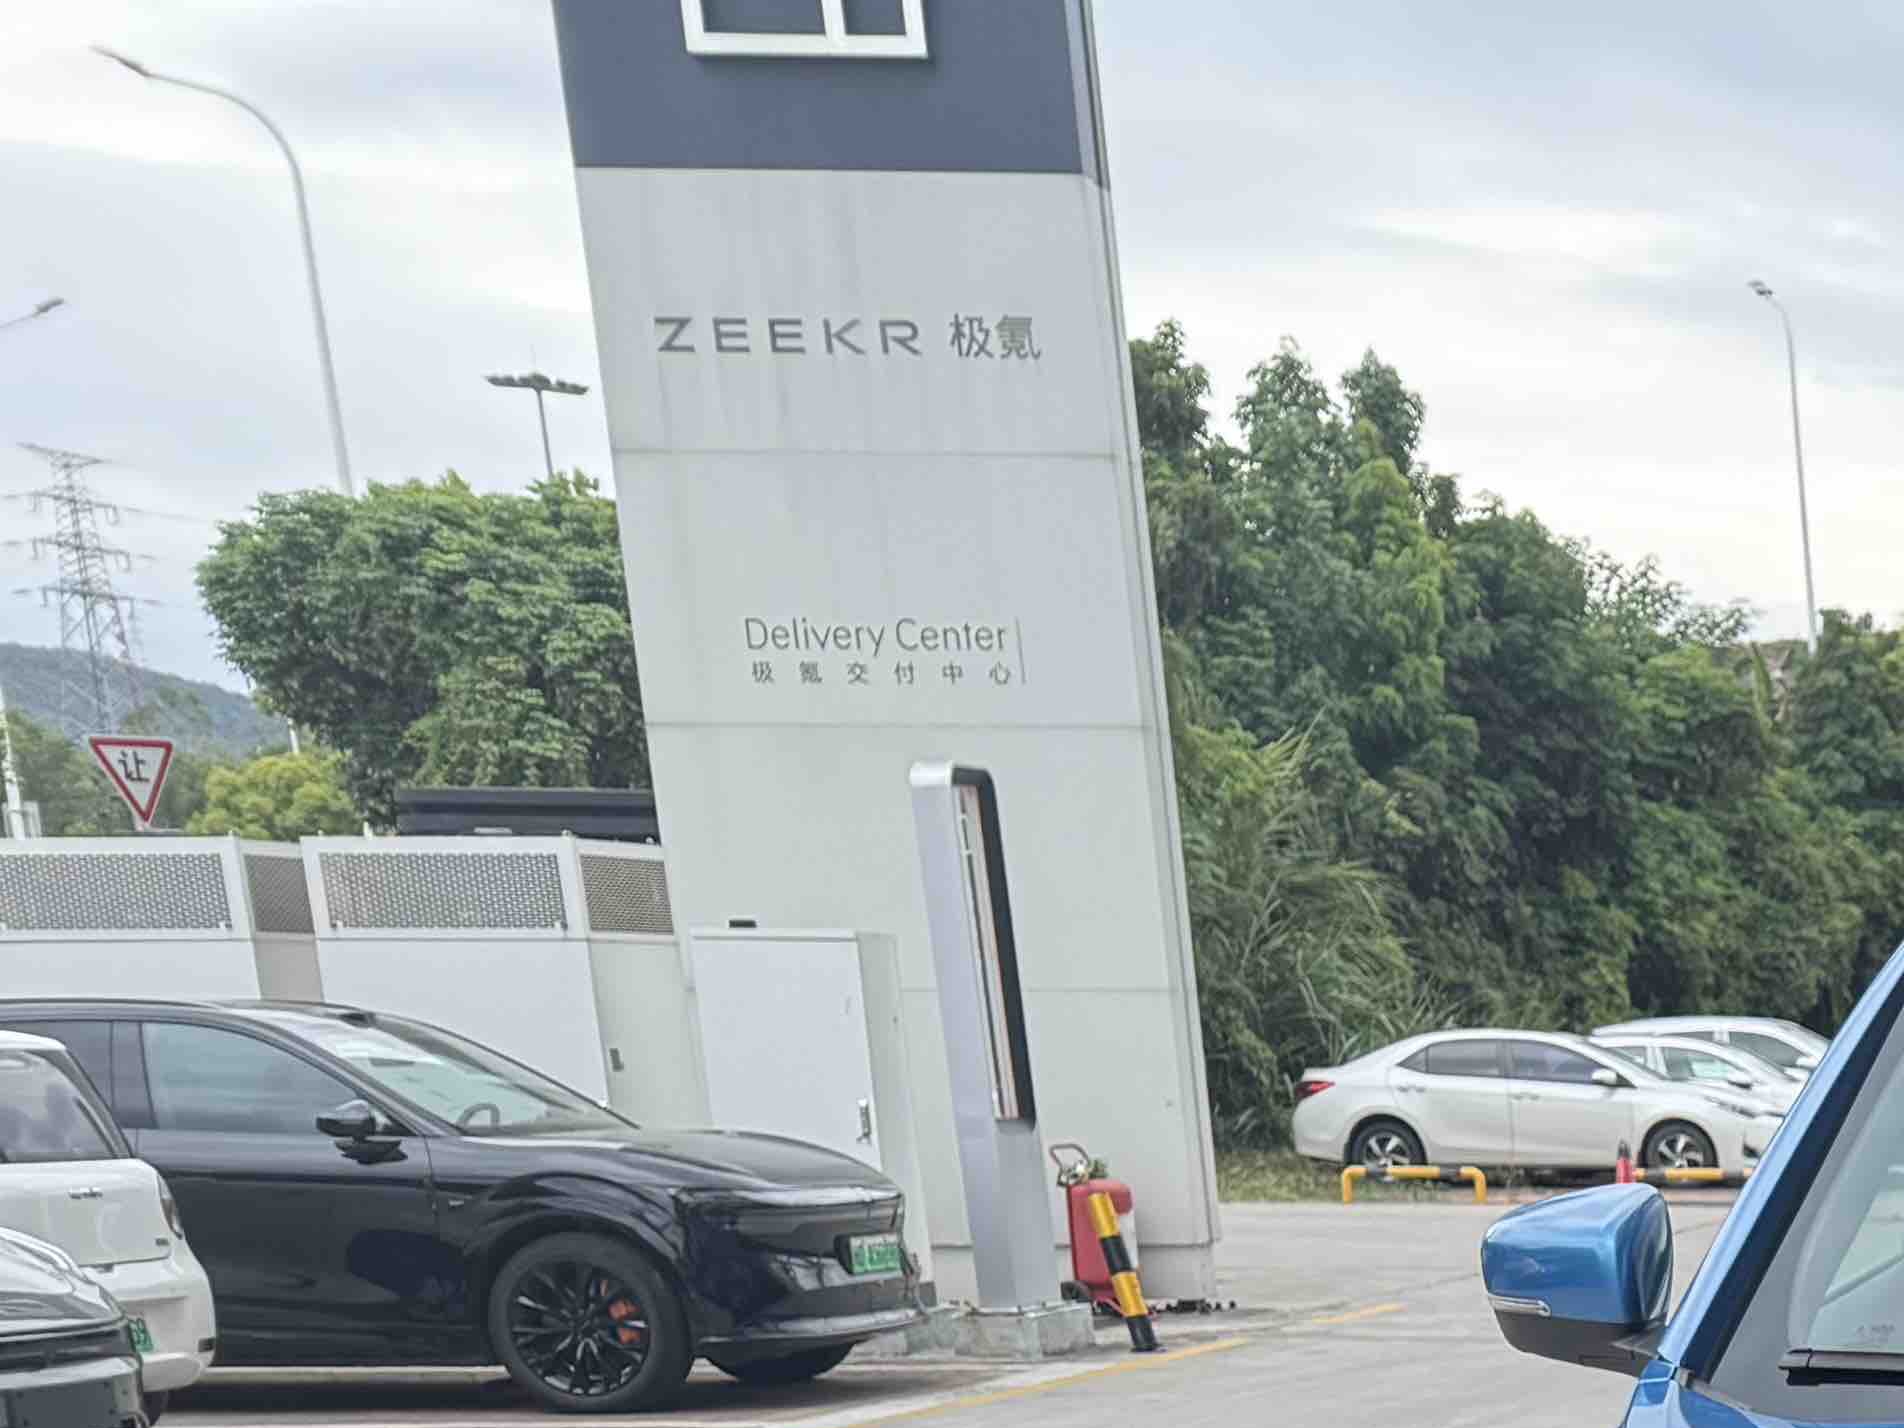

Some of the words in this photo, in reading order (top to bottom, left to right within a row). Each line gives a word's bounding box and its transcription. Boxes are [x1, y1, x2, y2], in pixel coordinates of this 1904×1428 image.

[653, 316, 923, 356] ZEEKR
[949, 312, 1041, 362] 极氪
[744, 616, 885, 657] Delivery
[895, 617, 1007, 651] Center
[751, 660, 1012, 686] 极氪交付中心
[117, 749, 150, 783] 让
